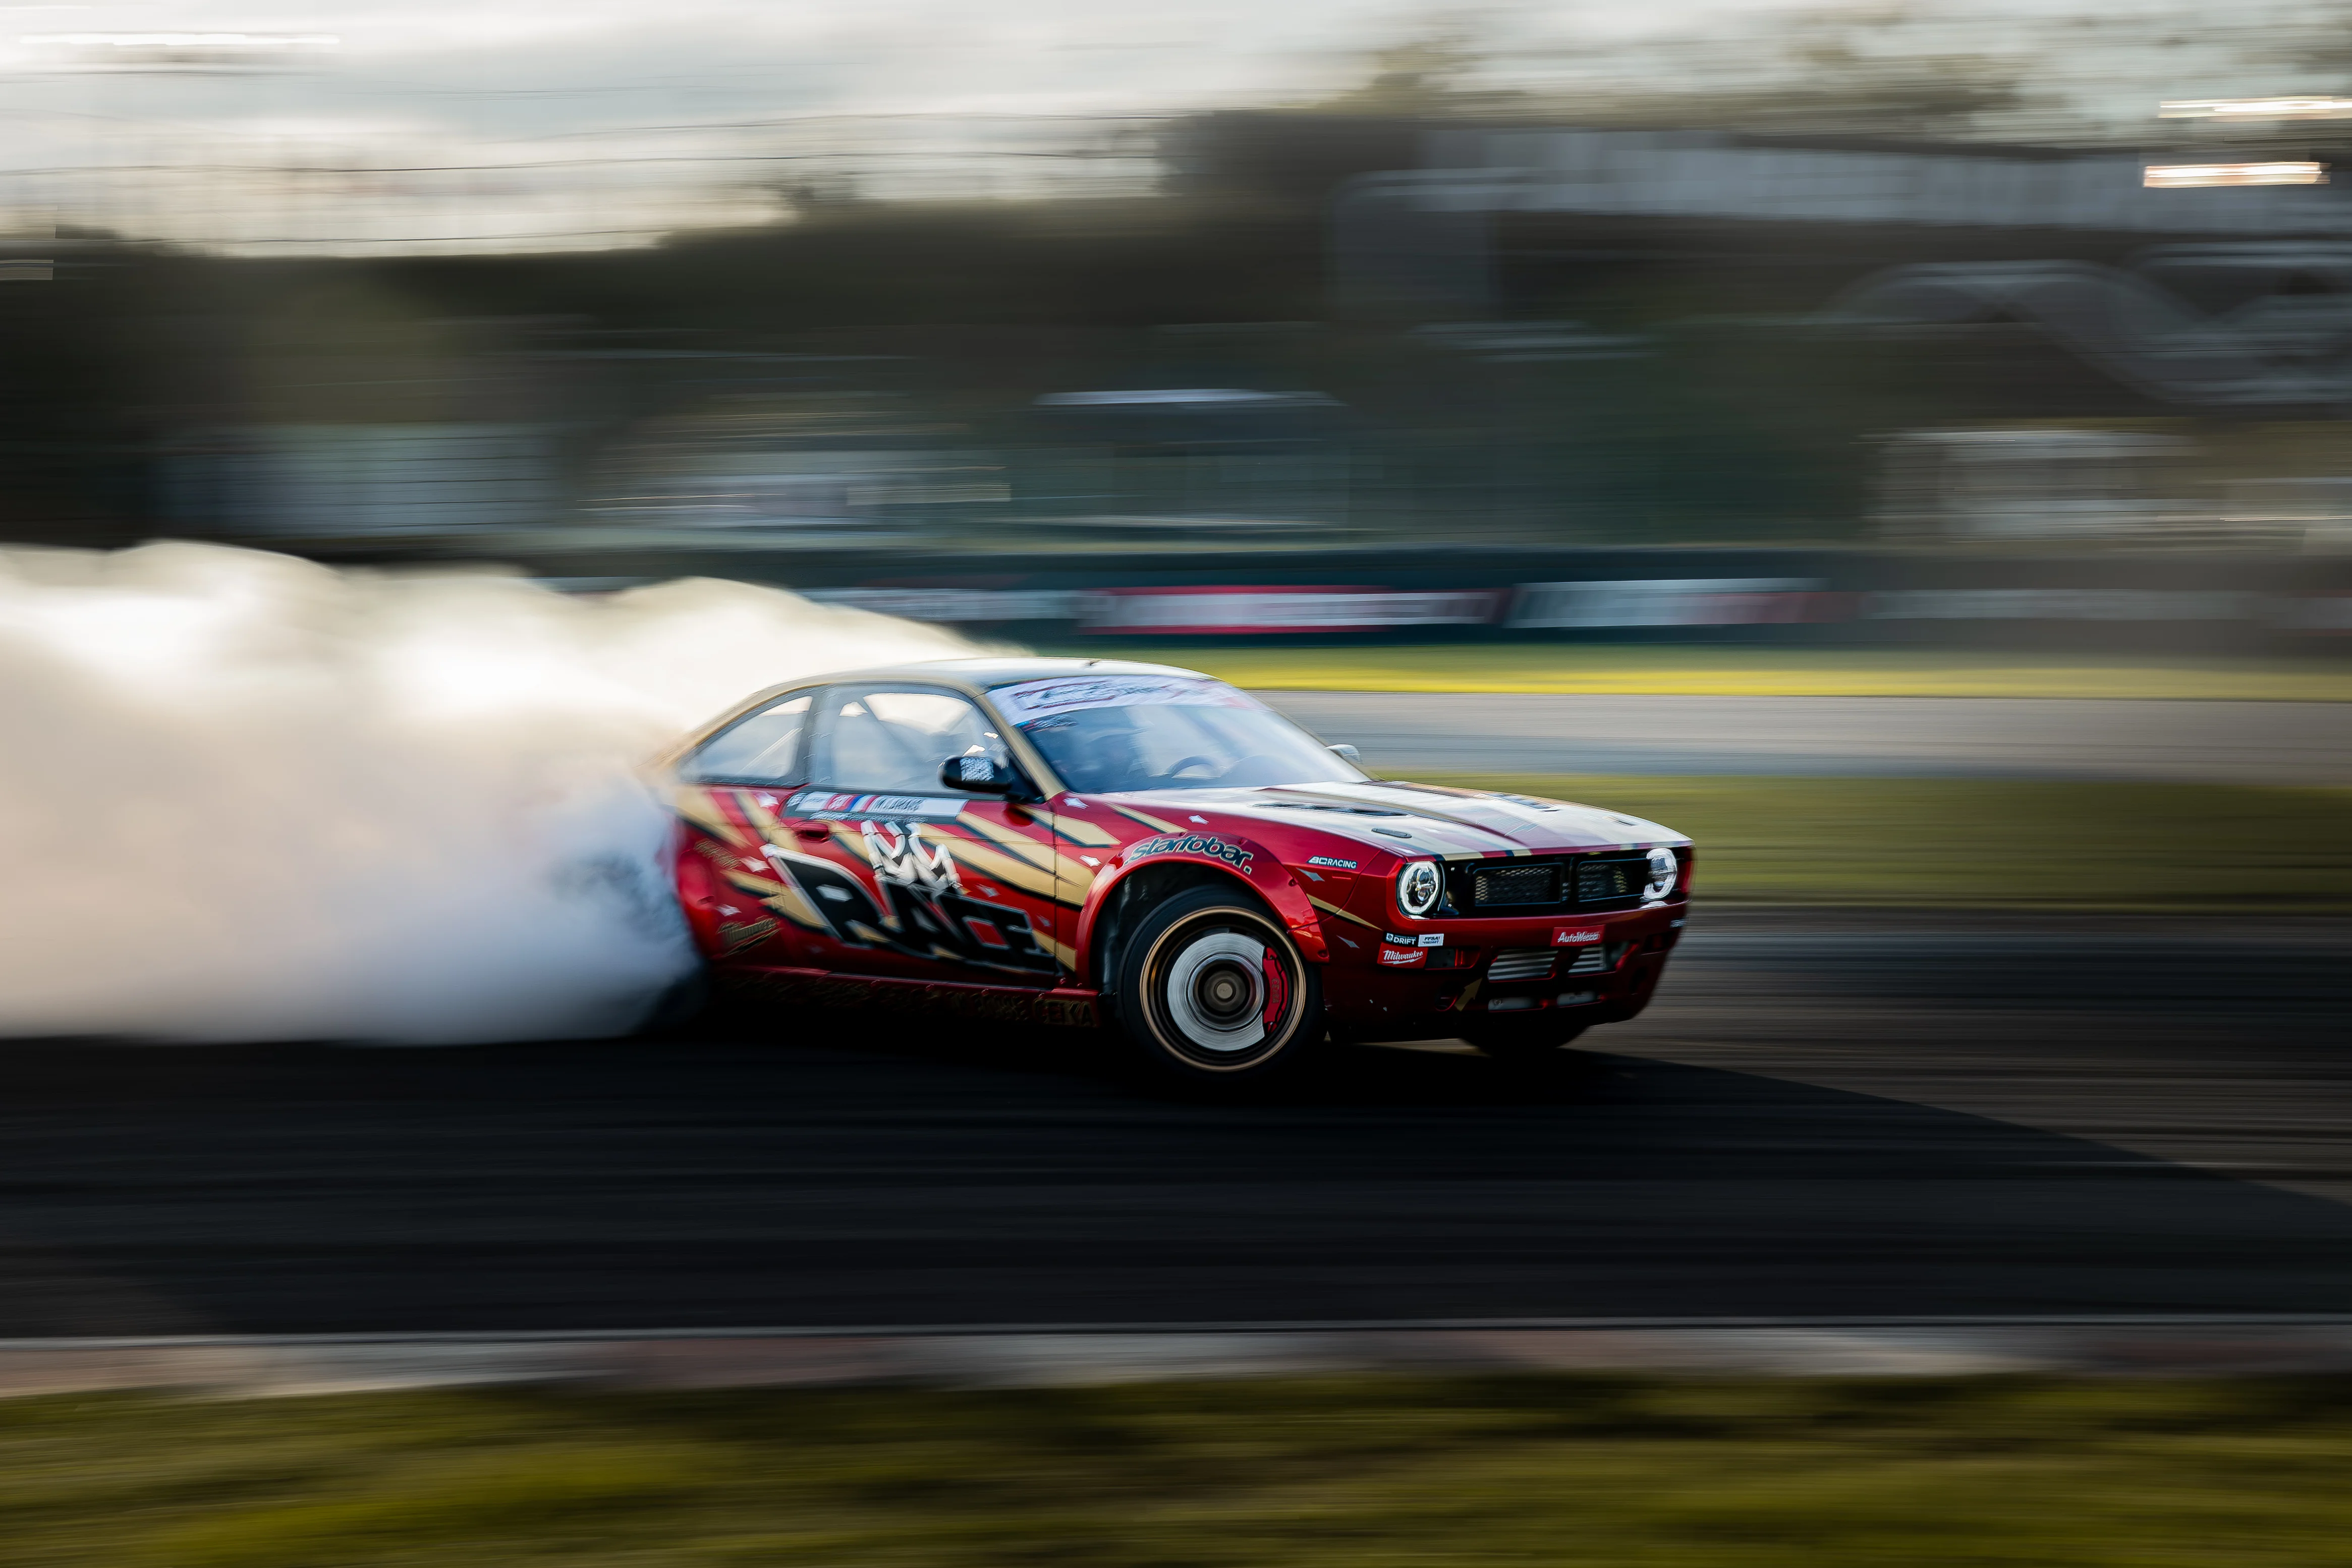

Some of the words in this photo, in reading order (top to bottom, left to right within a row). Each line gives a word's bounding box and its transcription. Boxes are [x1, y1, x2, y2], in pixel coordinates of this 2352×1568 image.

[1327, 858, 1357, 869] RACING
[1393, 936, 1416, 945] DRIFT
[1383, 949, 1423, 961] Milwaukee
